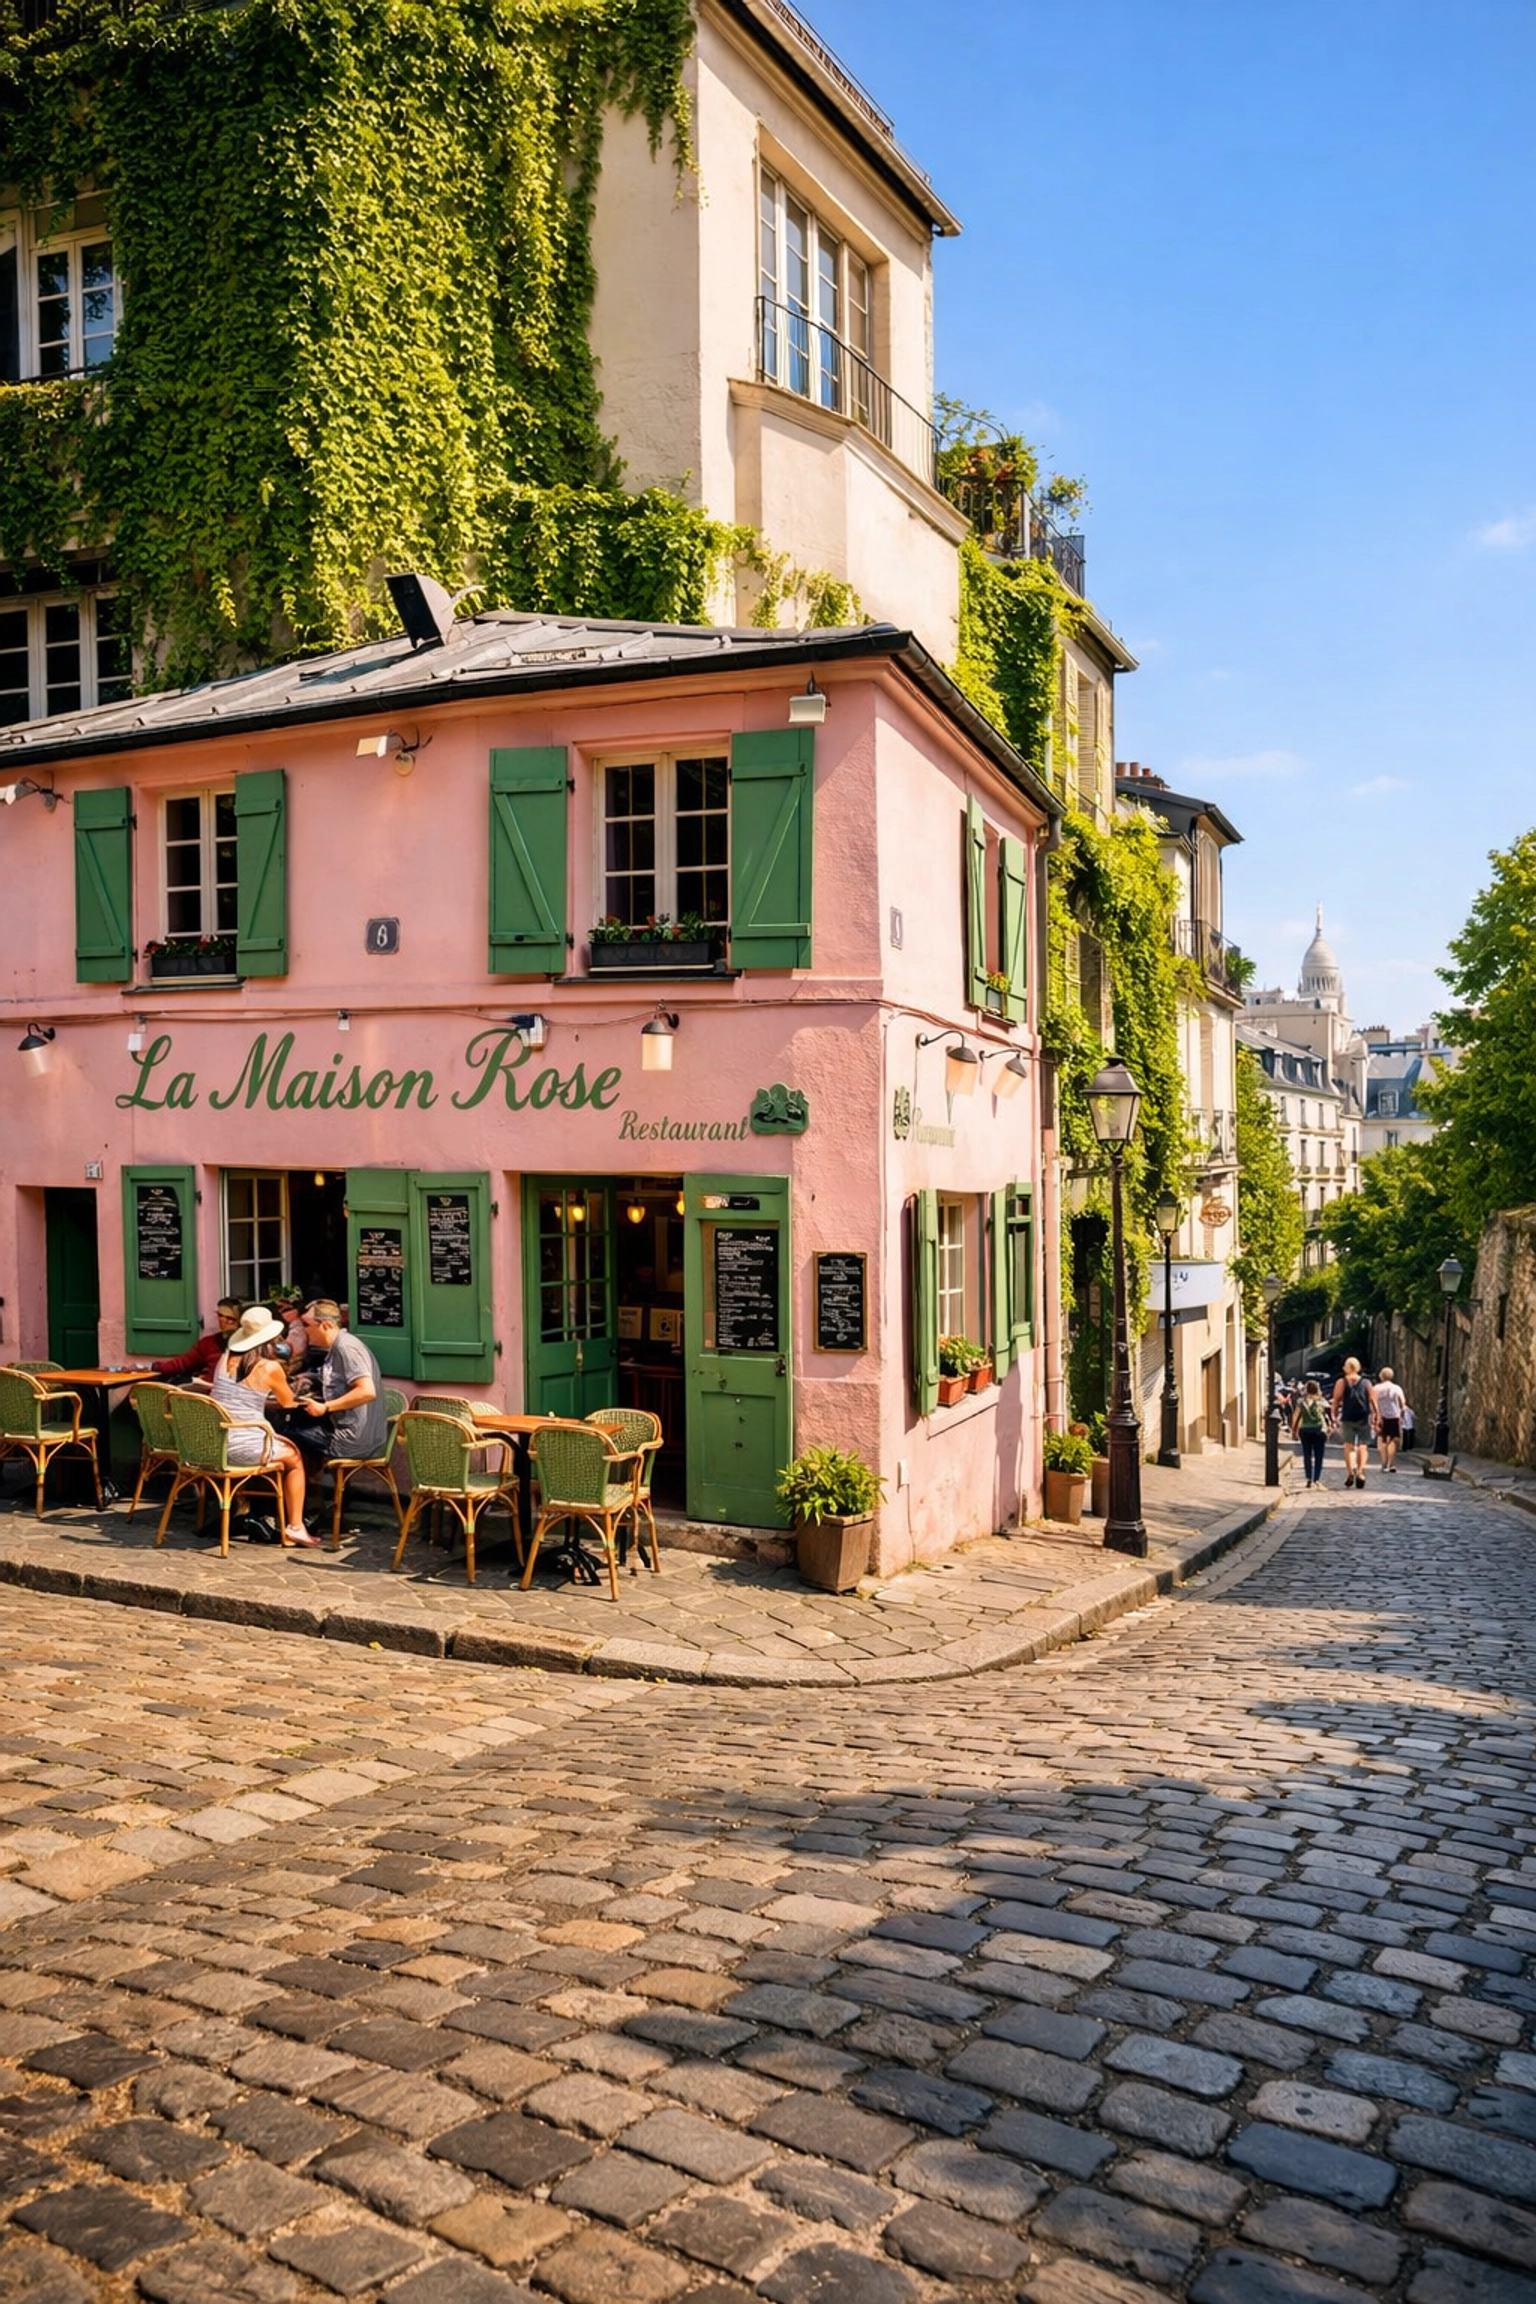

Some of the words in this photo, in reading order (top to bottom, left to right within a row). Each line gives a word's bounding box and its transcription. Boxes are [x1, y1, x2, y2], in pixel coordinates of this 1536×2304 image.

[115, 1034, 199, 1111] La
[208, 1031, 439, 1111] Maison
[451, 1026, 622, 1111] Rose
[618, 1109, 749, 1141] Restaurant
